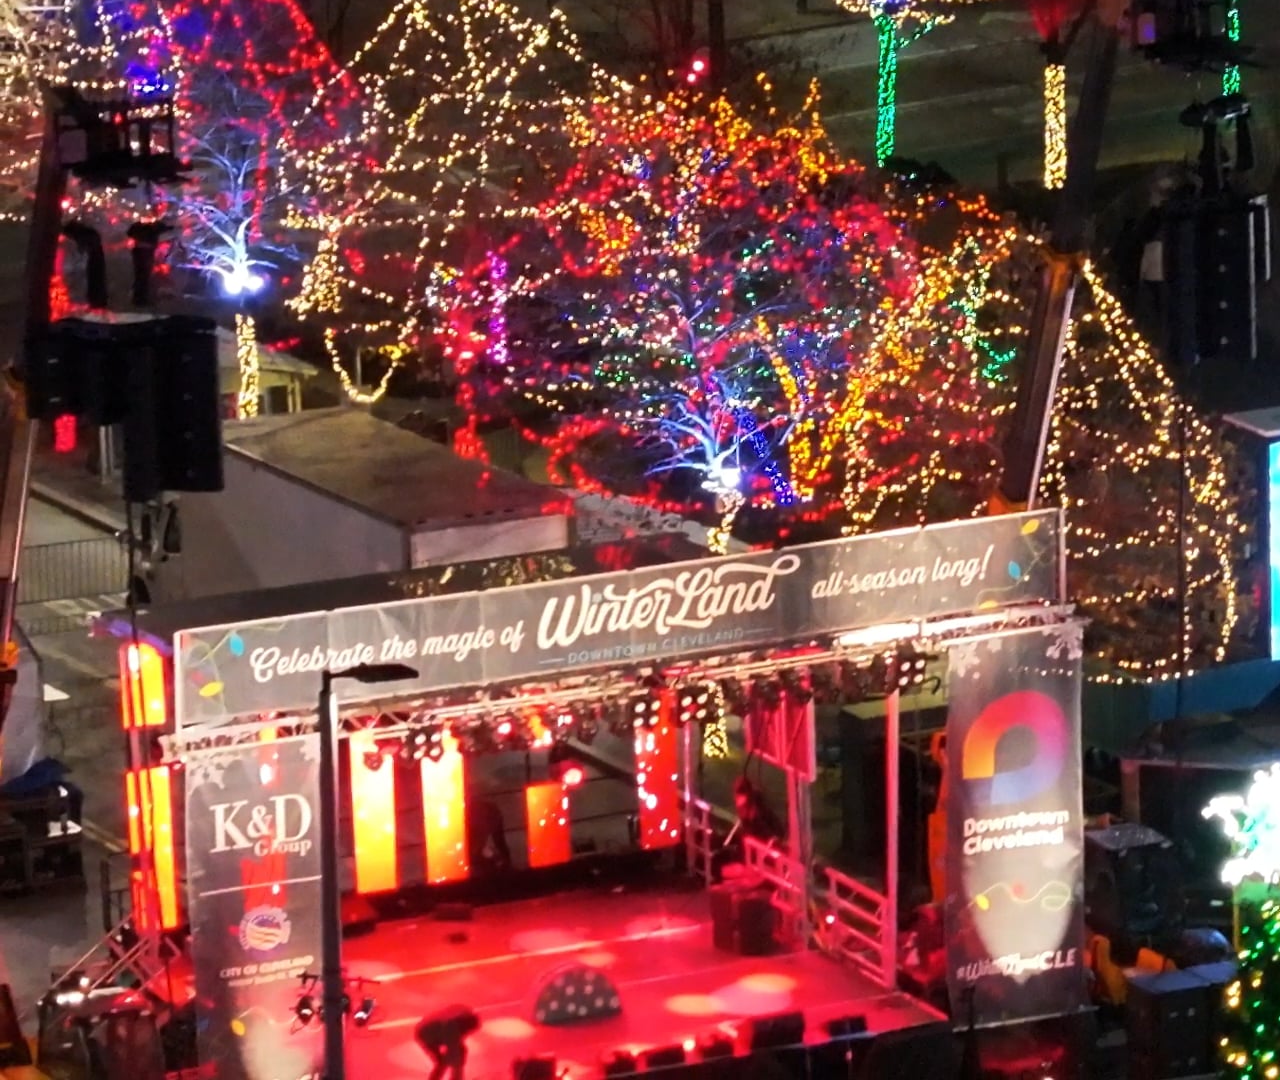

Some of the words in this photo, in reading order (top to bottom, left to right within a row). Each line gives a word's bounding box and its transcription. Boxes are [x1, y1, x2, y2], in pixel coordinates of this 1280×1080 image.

[931, 543, 995, 588] long!
[536, 554, 801, 650] WinterLand
[250, 643, 375, 683] Celebrate
[380, 634, 418, 662] the
[421, 624, 495, 662] magic
[500, 620, 526, 653] of
[567, 642, 657, 665] DOWNTOWN
[661, 626, 745, 650] CLEVELAND
[208, 793, 313, 854] K&D
[963, 809, 1070, 838] Downtown
[963, 826, 1065, 856] Cleveland
[253, 838, 313, 857] Group
